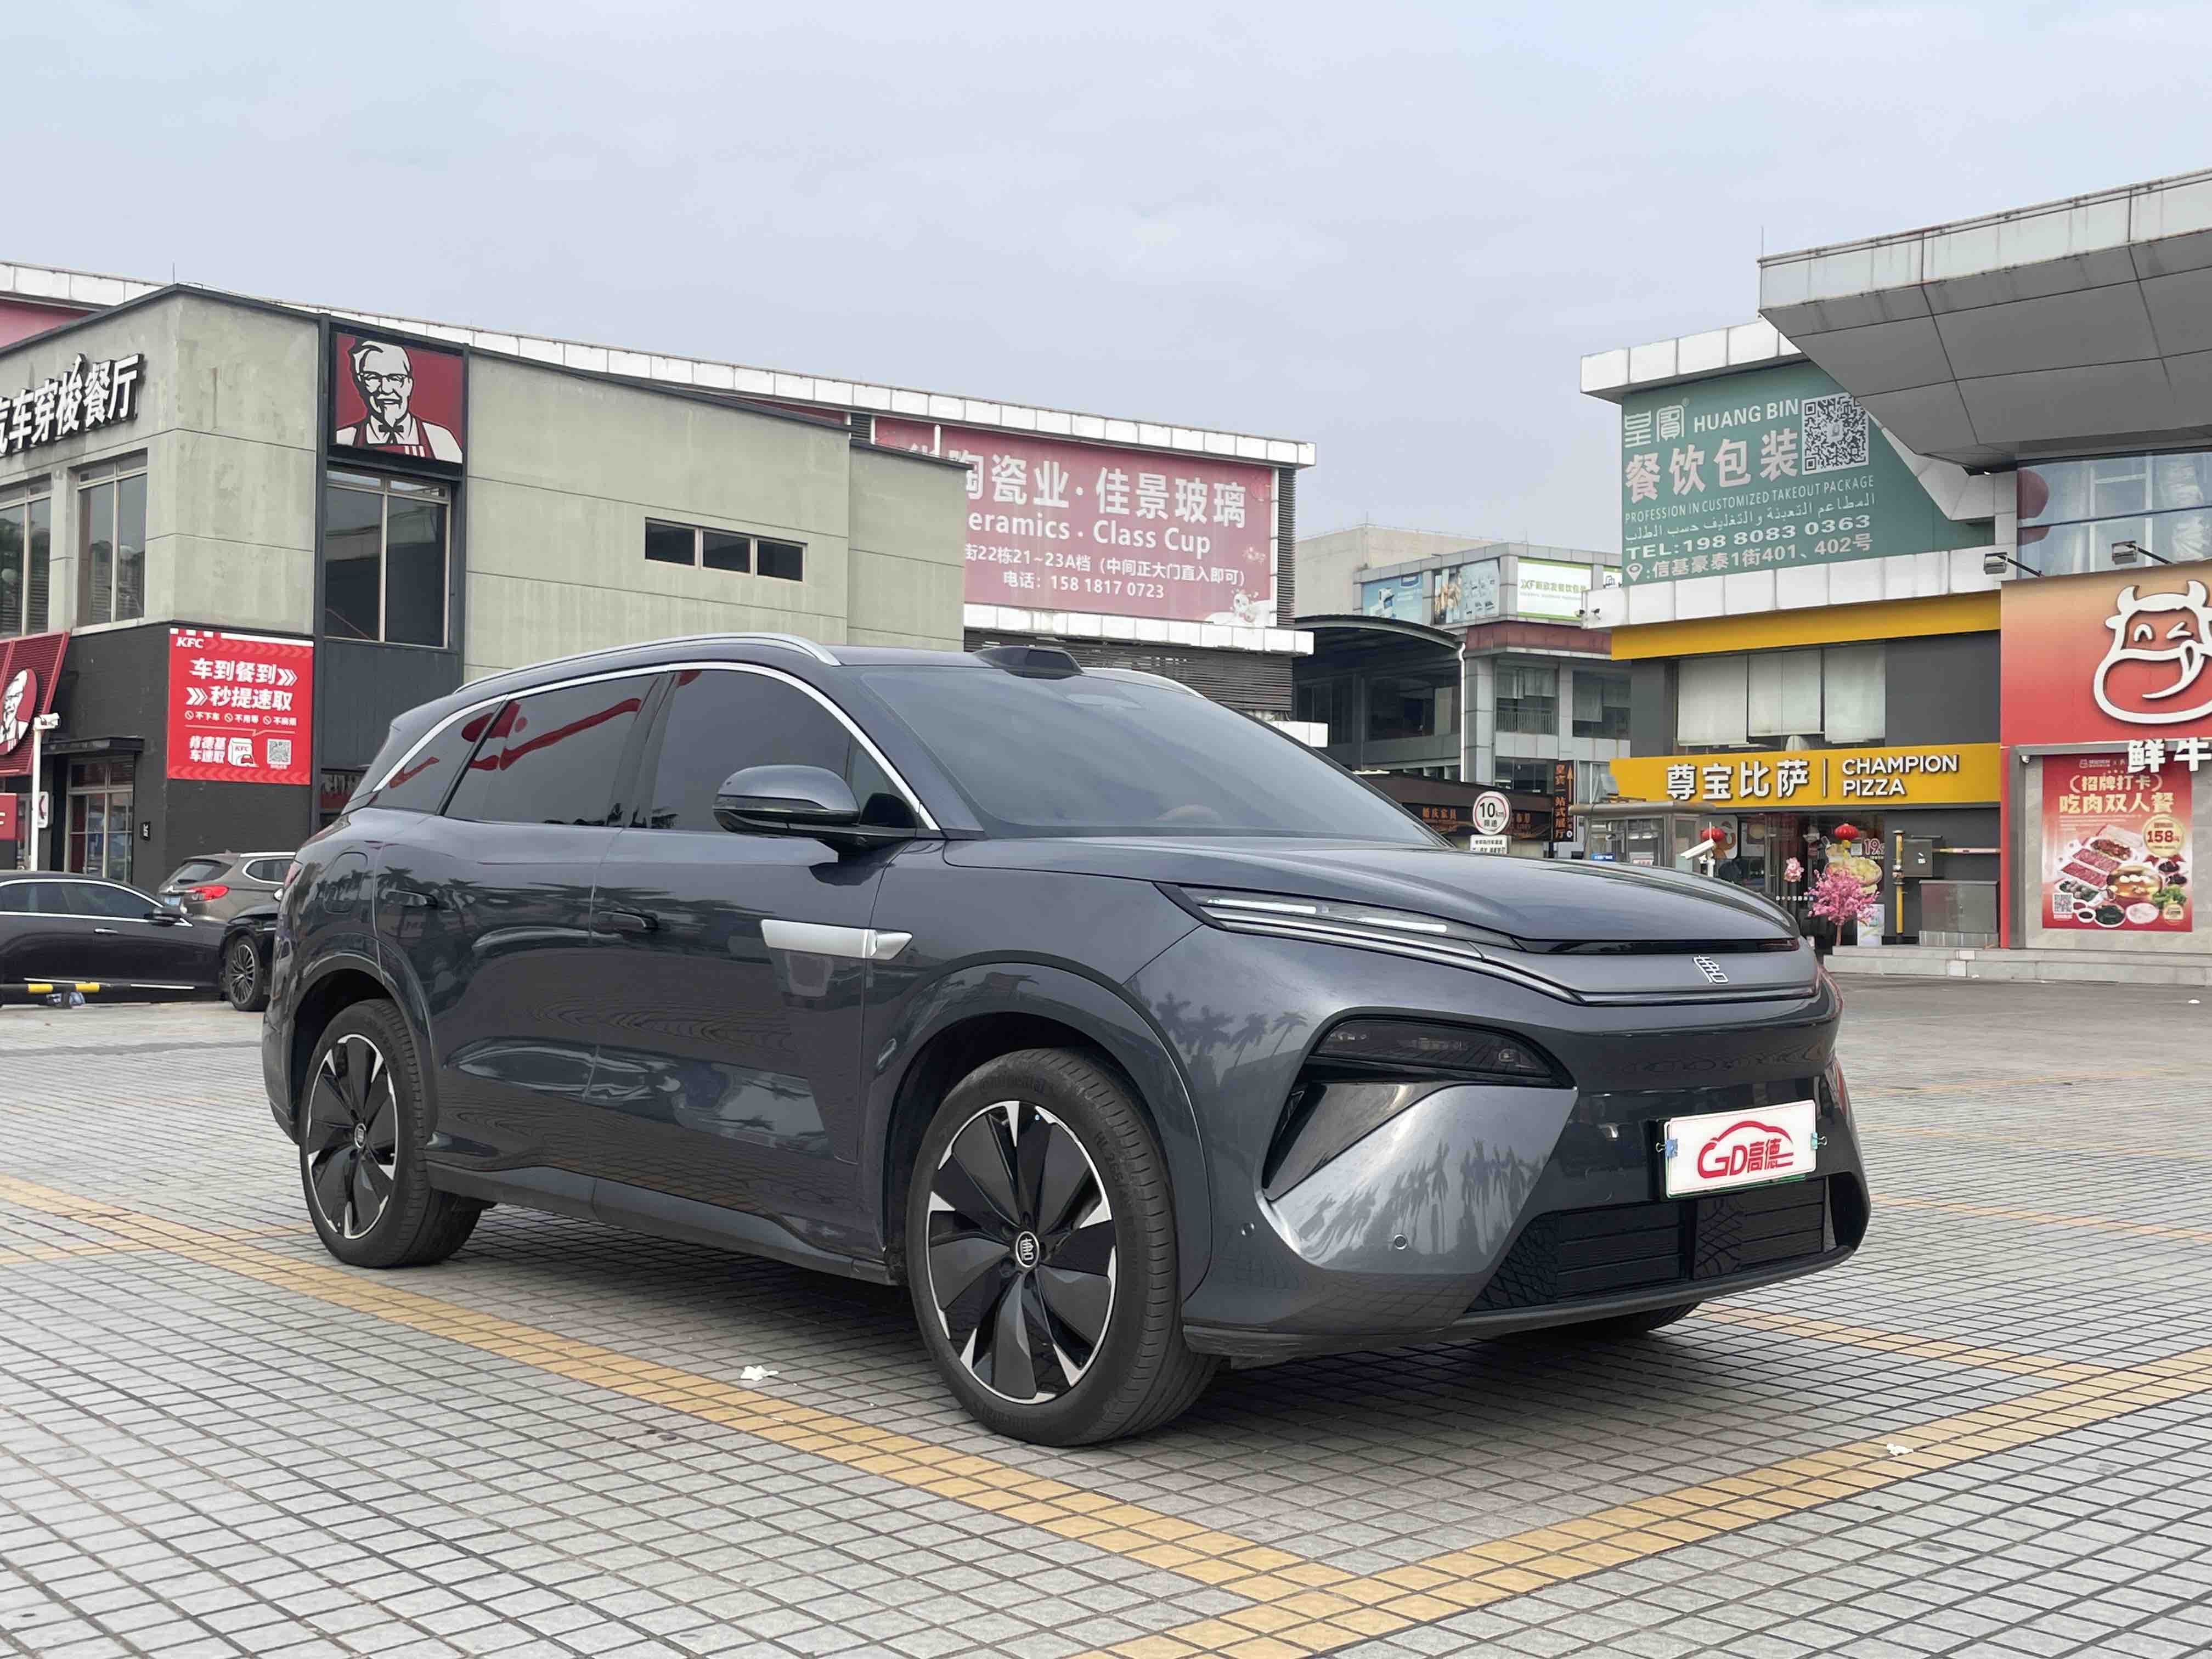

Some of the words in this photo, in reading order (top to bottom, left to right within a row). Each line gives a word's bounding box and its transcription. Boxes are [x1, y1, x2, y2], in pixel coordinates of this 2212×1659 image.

[1694, 405, 1761, 433] HUANG
[1767, 398, 1799, 420] BIN
[1626, 428, 1798, 504] 餐饮包装
[1625, 504, 1686, 523] PROFESSION
[1689, 503, 1699, 514] IN
[1702, 491, 1769, 512] CUSTOMIZED
[1772, 483, 1821, 501] TAKEOUT
[1824, 475, 1874, 493] PACKAGE
[968, 511, 1070, 539] eramics
[1093, 520, 1156, 548] Class
[1164, 527, 1211, 560] Cup
[1734, 525, 1796, 545] 8083
[1804, 515, 1870, 535] 0363
[1085, 578, 1122, 595] 1817
[1127, 582, 1164, 599] 0723
[176, 636, 205, 649] KFC
[189, 658, 277, 685] 车到餐到
[208, 686, 293, 712] 秒提速取
[1842, 755, 1958, 775] CHAMPION
[2128, 737, 2212, 773] 鲜牛
[1667, 759, 1808, 800] 尊宝比萨
[1843, 778, 1905, 796] PIZZA
[2059, 792, 2174, 814] 吃肉双人餐
